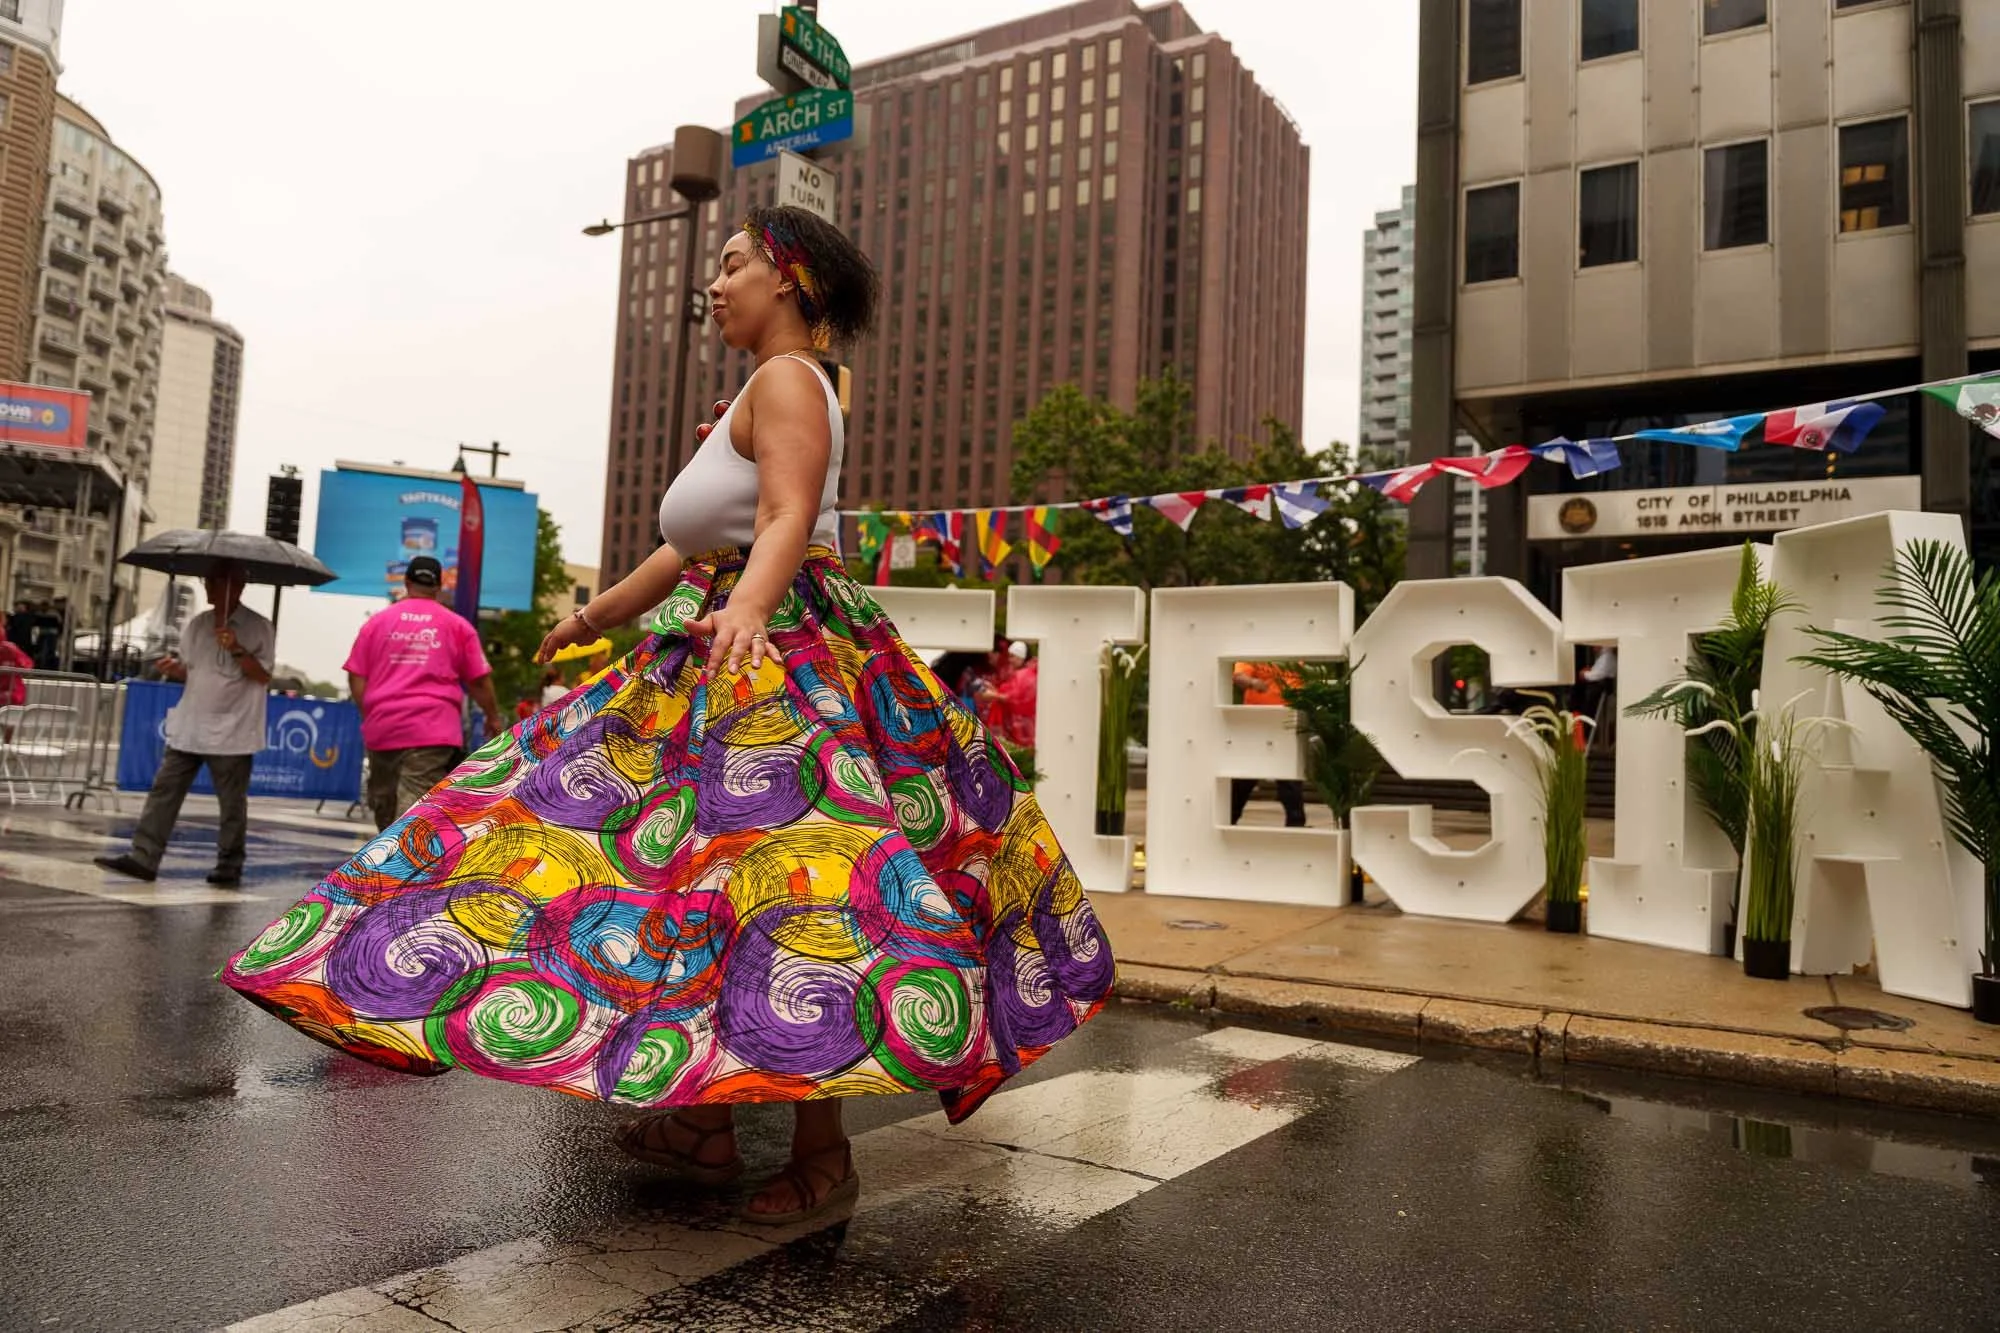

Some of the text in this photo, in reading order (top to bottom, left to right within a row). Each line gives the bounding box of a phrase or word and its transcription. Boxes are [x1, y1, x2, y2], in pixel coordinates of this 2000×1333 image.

[760, 102, 820, 140] ARCH
[826, 98, 847, 119] ST
[798, 166, 821, 189] NO
[789, 183, 825, 212] TURN
[1636, 487, 1852, 510] CITY OF PHILADELPHIA
[1679, 511, 1722, 526] ARCH
[1733, 508, 1801, 524] STREET
[400, 612, 433, 622] STAFF
[862, 510, 1975, 1008] IESTA
